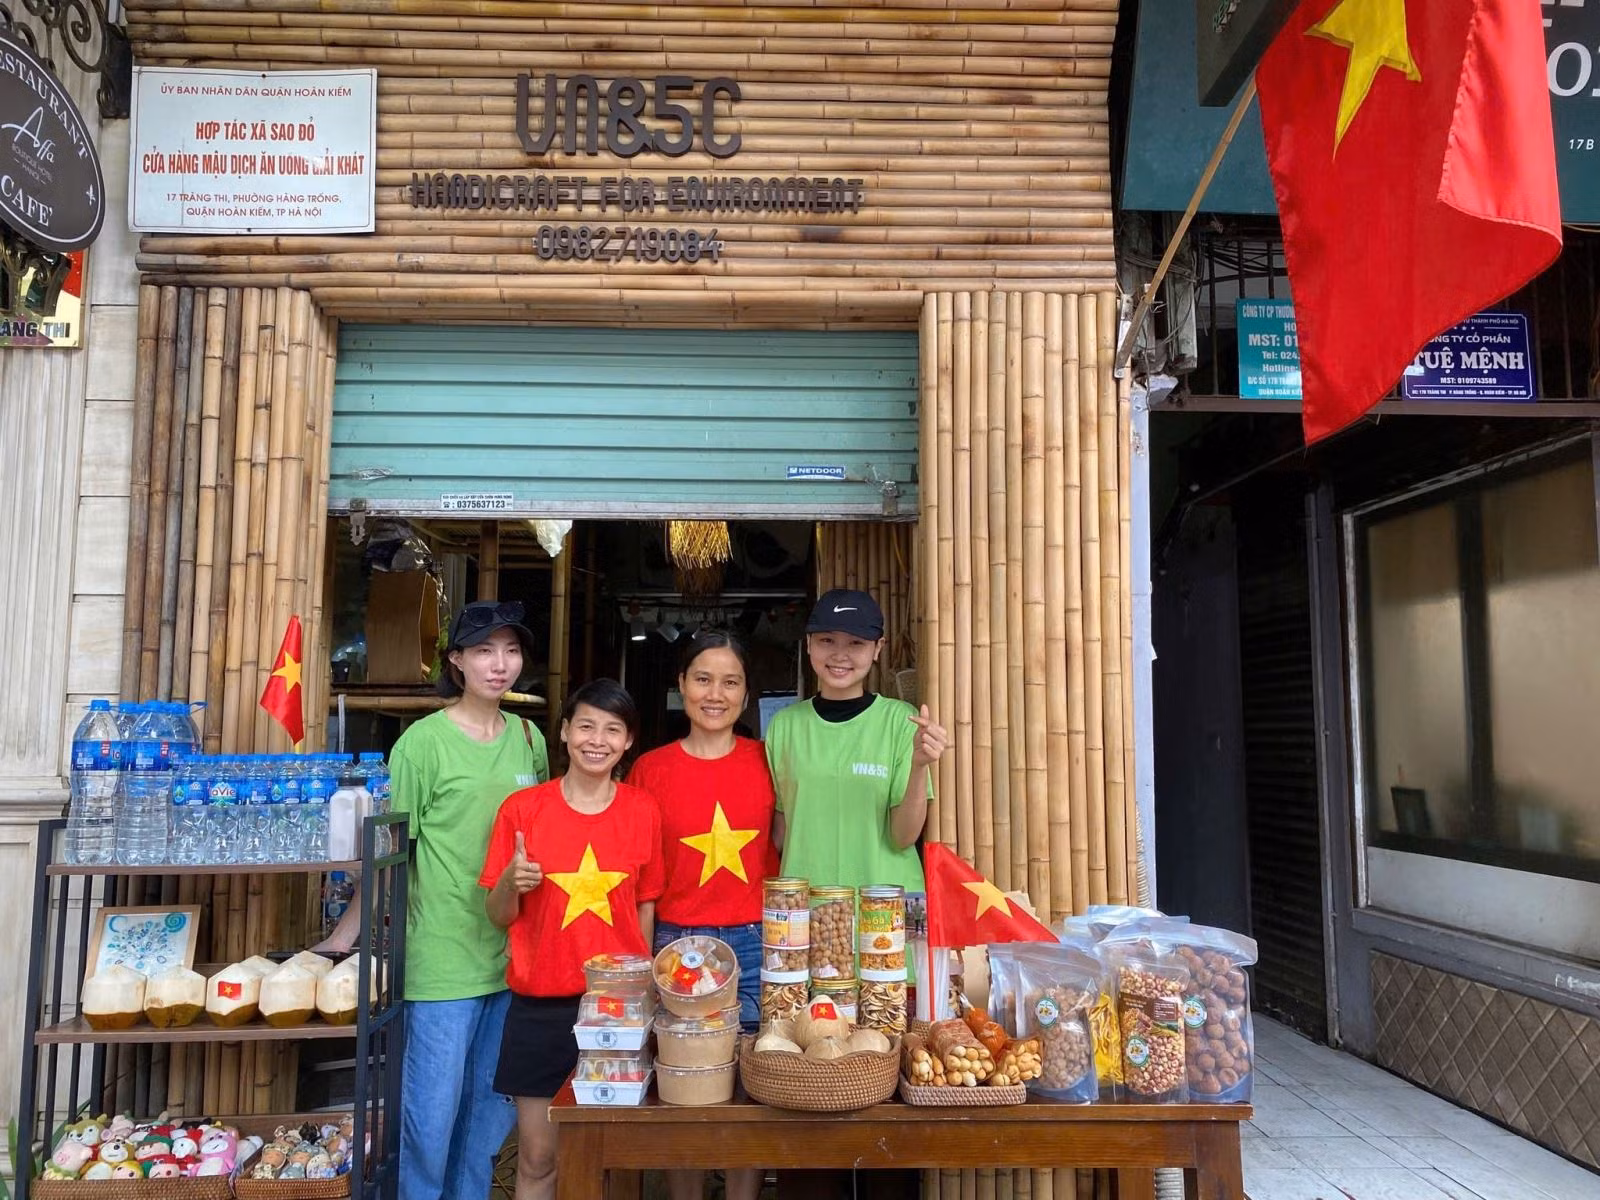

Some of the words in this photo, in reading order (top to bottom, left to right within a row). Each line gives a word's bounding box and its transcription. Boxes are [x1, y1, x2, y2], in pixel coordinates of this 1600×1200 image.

[177, 85, 198, 95] BAN
[201, 85, 231, 96] NHÂN
[235, 86, 258, 96] DÂN
[261, 86, 291, 99] QUẬN
[294, 86, 325, 97] HOÀN
[515, 73, 743, 159] VN&5C
[195, 120, 220, 144] HỢP
[224, 118, 247, 140] TÁC
[250, 119, 266, 141] XÃ
[271, 122, 295, 141] SAO
[299, 116, 315, 141] ĐỎ
[142, 145, 165, 174] CỬA
[168, 150, 199, 174] HÀNG
[202, 150, 227, 179] MẬU
[230, 154, 257, 179] DỊCH
[260, 150, 275, 175] ĂN
[337, 151, 365, 175] KHÁT
[167, 193, 177, 202] 17
[179, 192, 212, 202] TRÀNG
[276, 192, 305, 203] HÀNG
[410, 172, 588, 212] HANDICRAFT
[600, 176, 655, 213] FOR
[667, 176, 864, 214] ENVIRONMENT
[186, 206, 215, 218] QUẬN
[218, 206, 247, 217] HOÀN
[277, 208, 286, 217] TP
[288, 207, 302, 217] HÀ
[304, 206, 322, 218] NỘI
[536, 224, 721, 262] 0982719084
[43, 322, 71, 338] THI
[1248, 334, 1280, 347] MST:
[1451, 335, 1464, 343] TY
[1262, 351, 1278, 360] Tel:
[1460, 346, 1525, 374] MỆNH
[456, 500, 506, 509] 0375637123
